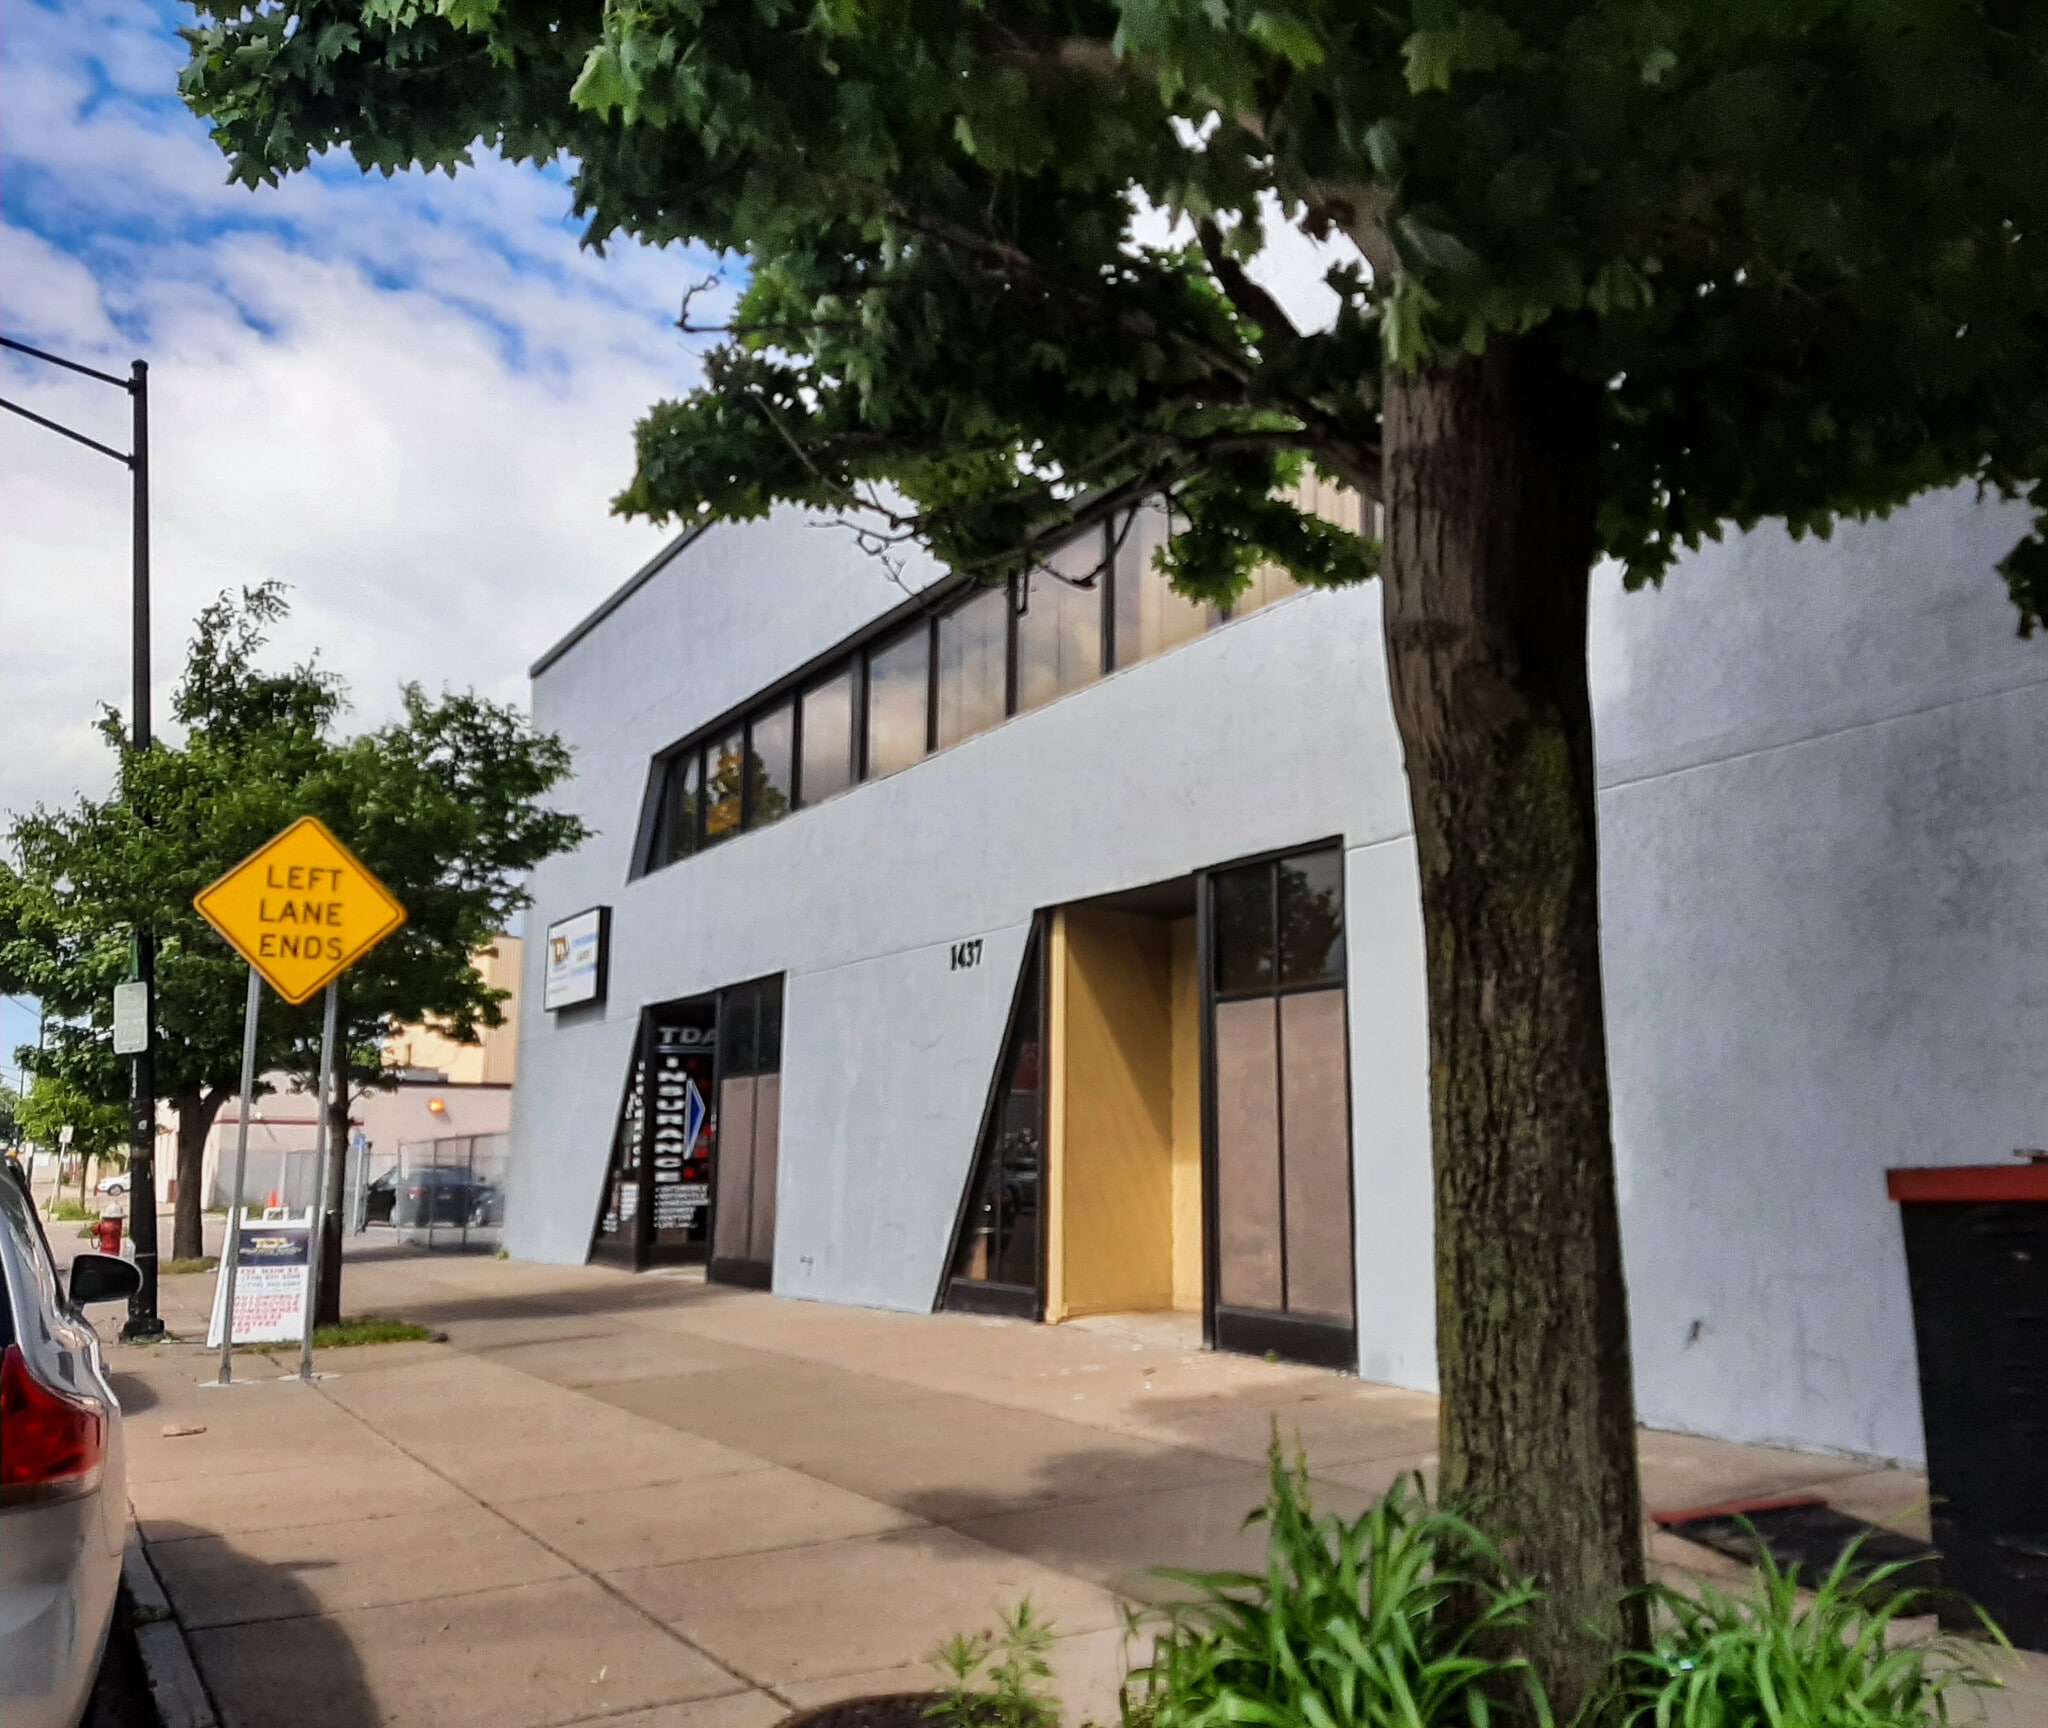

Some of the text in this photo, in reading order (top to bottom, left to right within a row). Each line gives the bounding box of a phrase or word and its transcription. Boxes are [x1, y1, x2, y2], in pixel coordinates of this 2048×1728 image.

[266, 864, 343, 892] LEFT
[259, 898, 343, 927] LANE
[259, 933, 343, 961] ENDS
[951, 939, 983, 971] 1437
